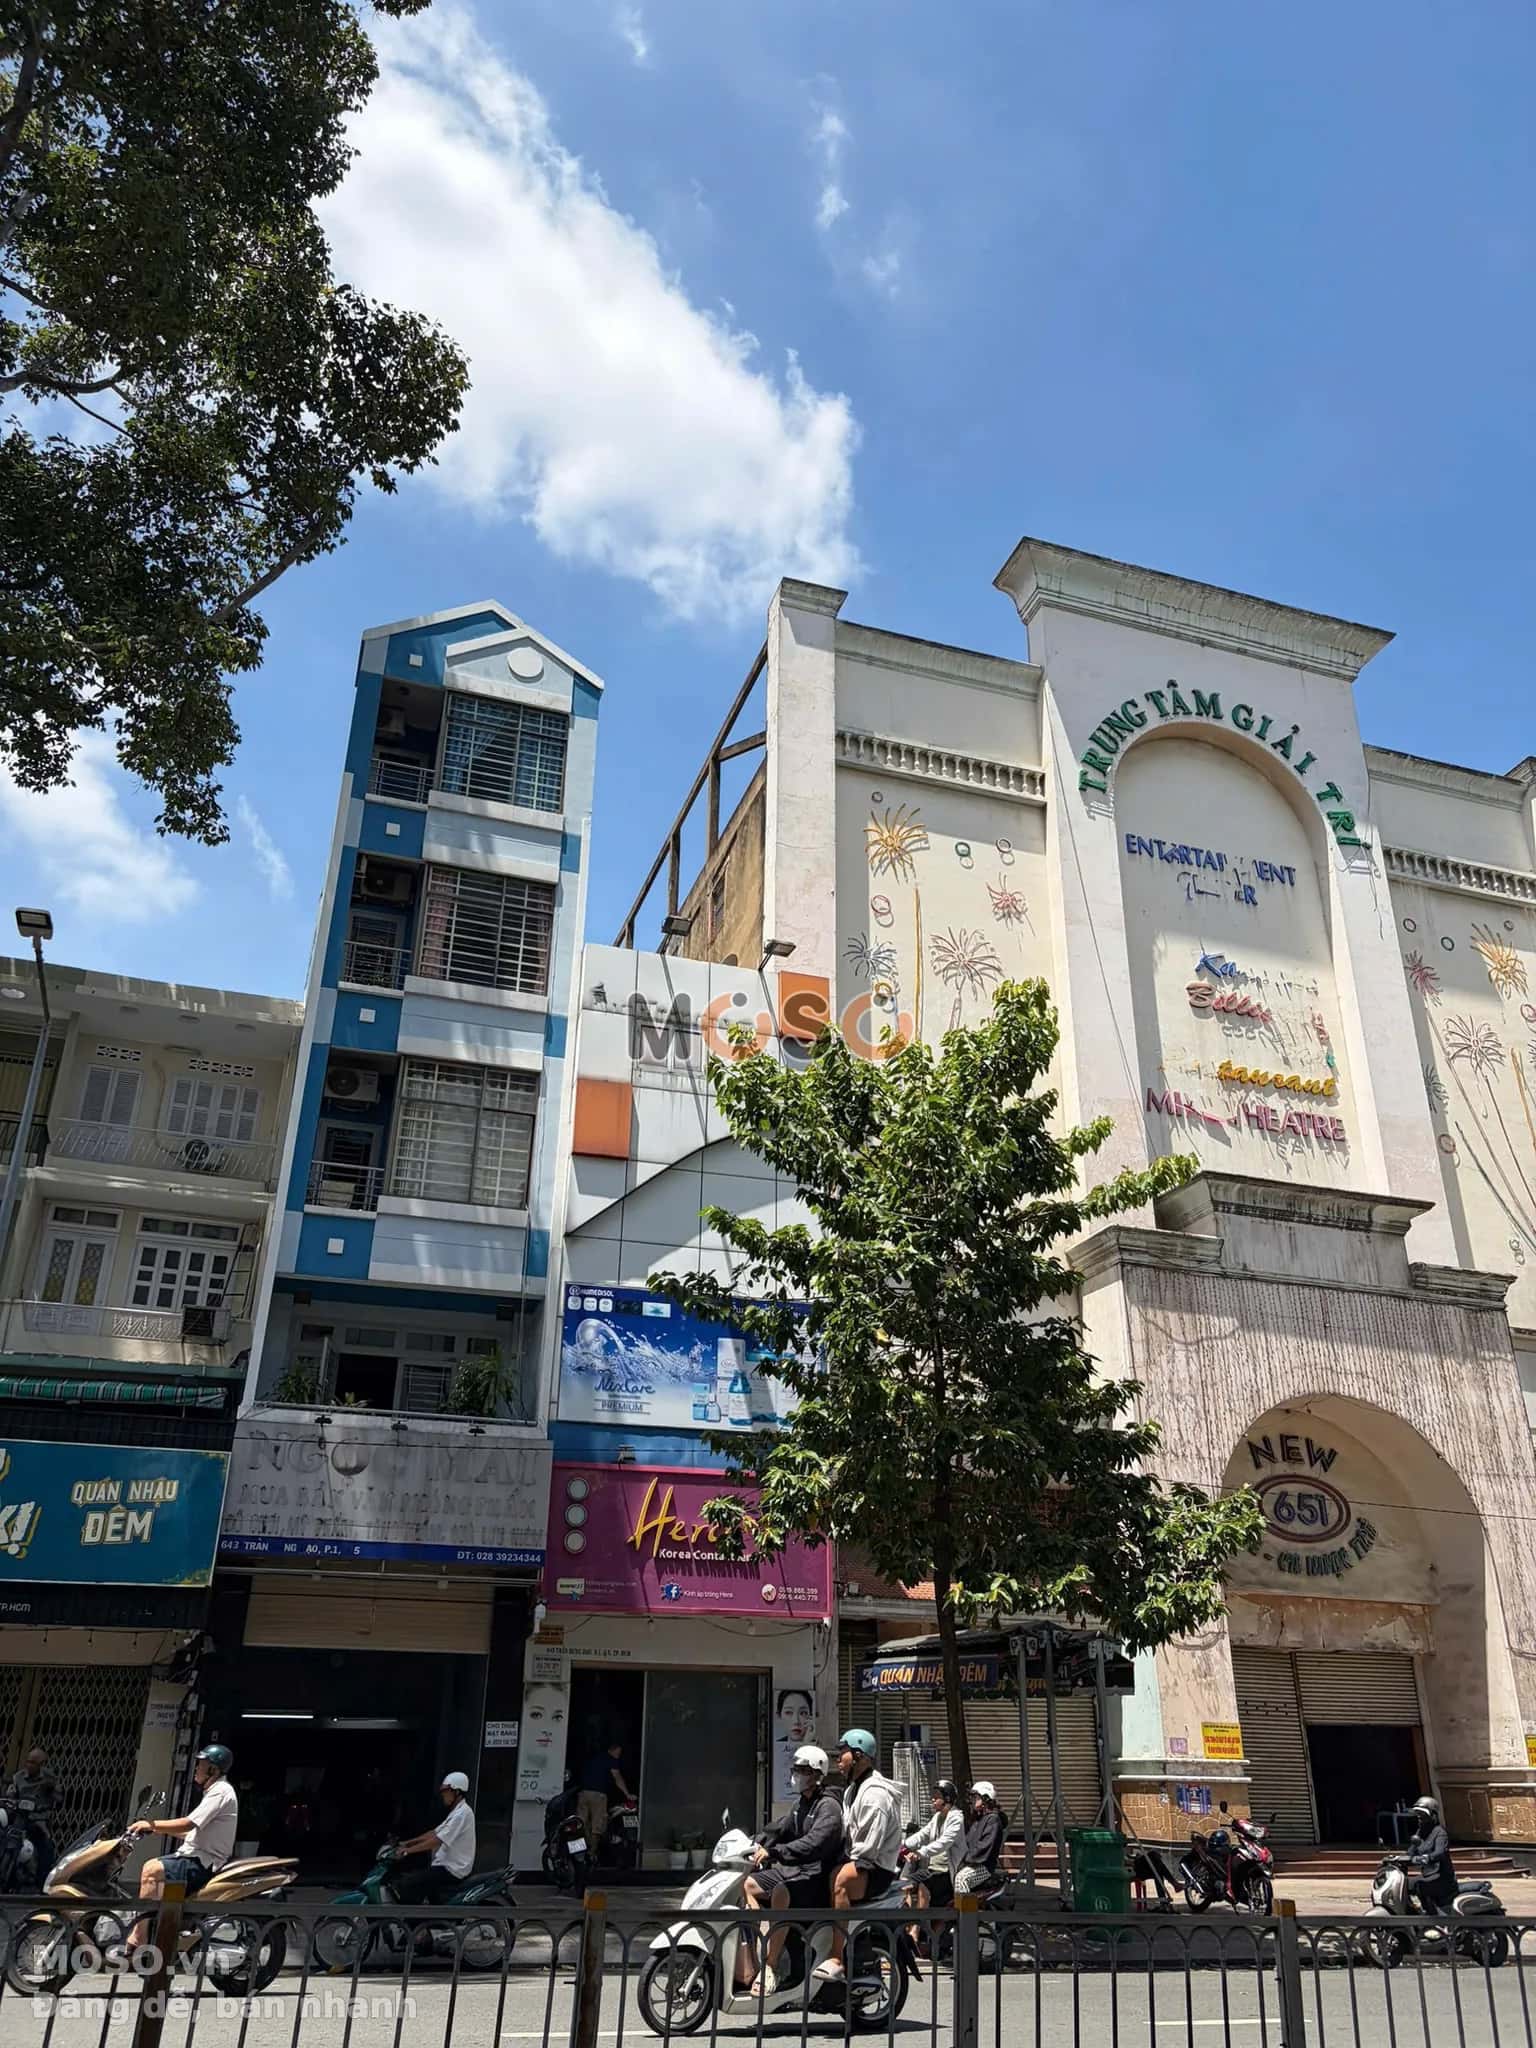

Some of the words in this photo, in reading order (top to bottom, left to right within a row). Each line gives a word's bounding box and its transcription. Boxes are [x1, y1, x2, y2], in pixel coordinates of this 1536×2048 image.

[1078, 697, 1149, 795] TRUNG
[1144, 679, 1224, 720] TÂM
[1230, 702, 1318, 777] GIẢI
[1247, 1433, 1339, 1473] NEW
[73, 1476, 123, 1508] QUÁN
[126, 1476, 179, 1508] NHẬU
[80, 1503, 155, 1545] ĐÊM
[1273, 1490, 1329, 1528] 651
[220, 1540, 239, 1550] 643
[476, 1551, 494, 1561] 028
[496, 1551, 542, 1563] 39234344
[658, 1548, 692, 1560] Korea
[880, 1664, 915, 1685] QUÁN
[916, 1663, 945, 1686] NHẬ
